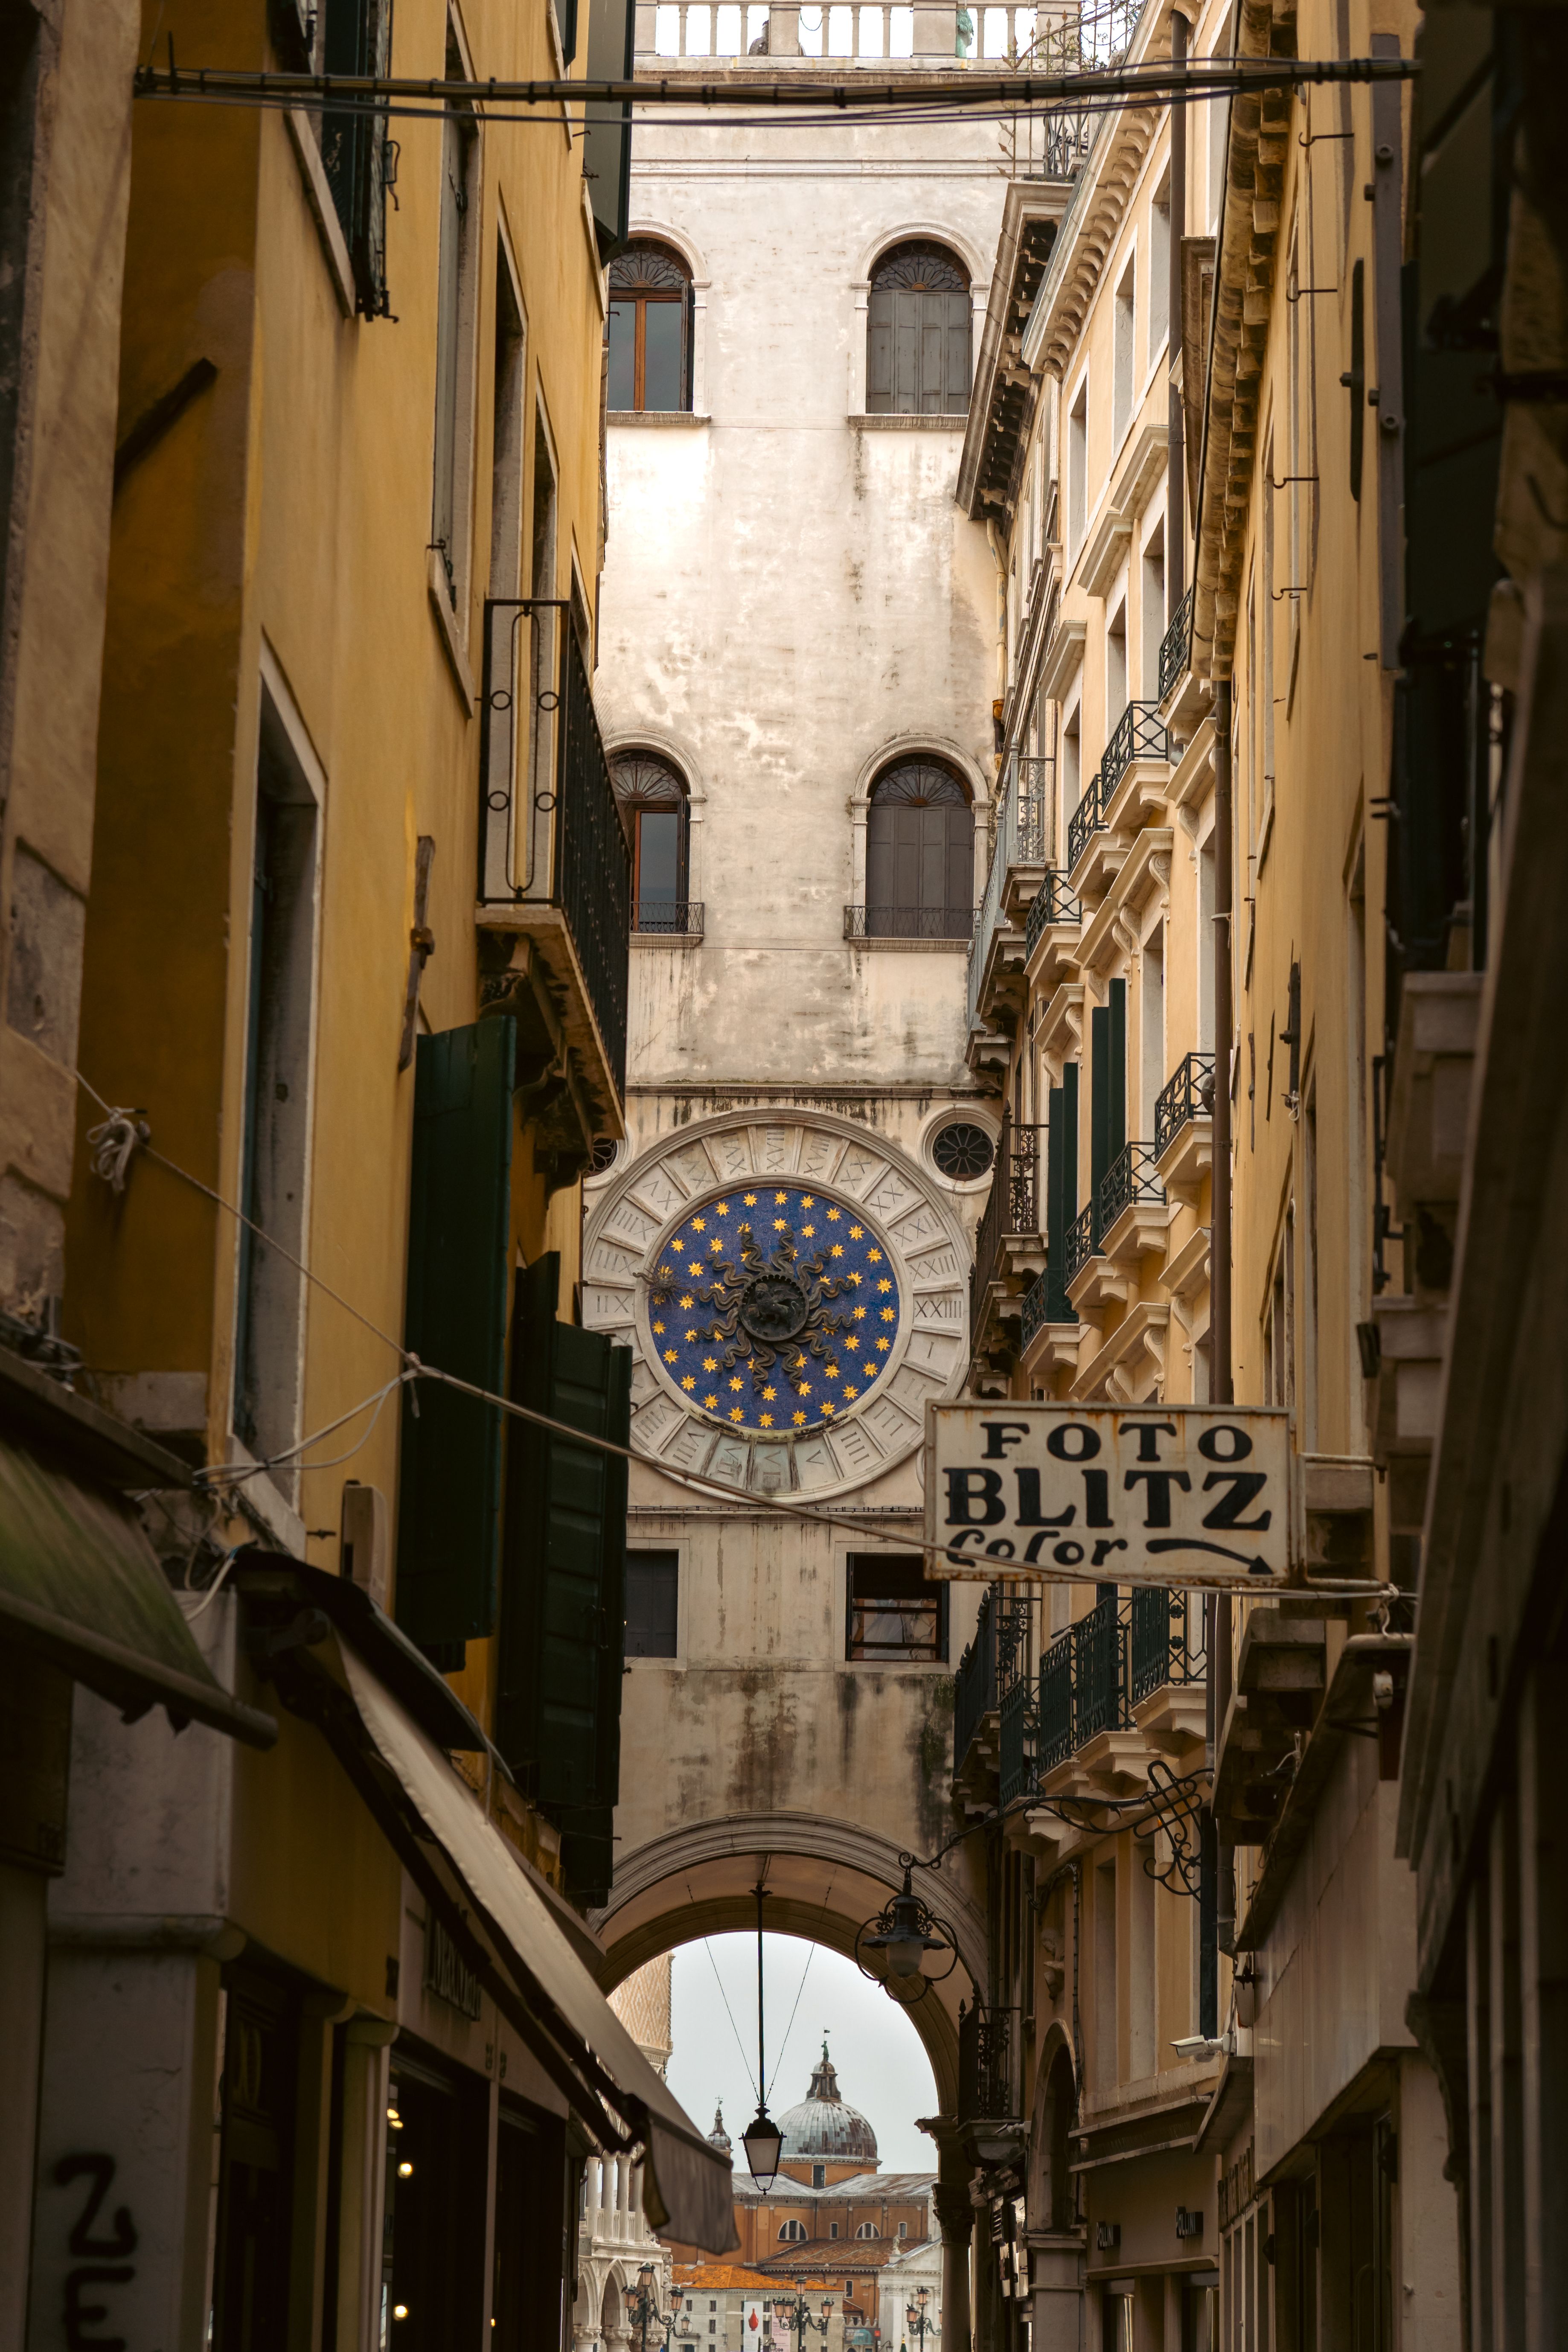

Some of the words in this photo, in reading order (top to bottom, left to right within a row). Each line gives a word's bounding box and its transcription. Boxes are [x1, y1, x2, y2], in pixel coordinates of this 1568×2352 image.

[677, 1147, 711, 1190] XVI
[721, 1132, 747, 1175] XVII
[839, 1153, 872, 1191] XX
[642, 1180, 679, 1212] XV
[869, 1177, 910, 1217] XXI
[611, 1207, 655, 1242] XIIII
[893, 1212, 939, 1247] XXII
[595, 1249, 637, 1276] XIII
[908, 1254, 957, 1282] XXIII
[597, 1295, 630, 1313] XII
[915, 1301, 962, 1318] XXIIII
[904, 1377, 926, 1400] II
[635, 1404, 677, 1439] VIIII
[873, 1406, 904, 1437] III
[672, 1432, 706, 1465] VIII
[806, 1449, 824, 1465] V
[841, 1432, 870, 1465] IIII
[980, 1422, 1253, 1462] FOTO
[942, 1467, 1272, 1531] BLITZ
[946, 1529, 1128, 1567] Color
